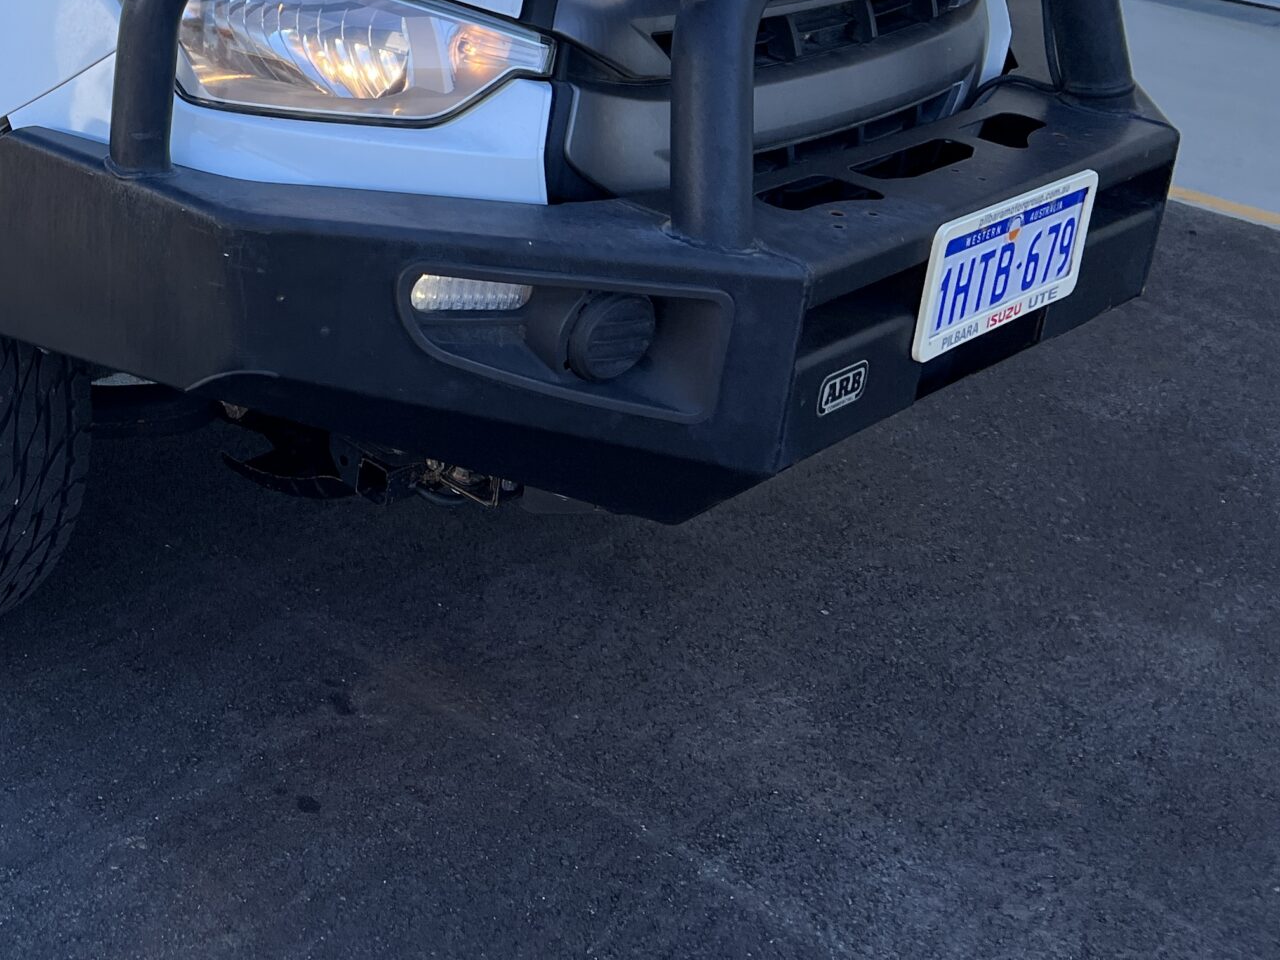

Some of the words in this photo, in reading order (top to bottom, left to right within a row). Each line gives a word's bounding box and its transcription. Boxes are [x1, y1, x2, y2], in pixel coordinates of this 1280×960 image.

[965, 225, 1002, 248] WESTERN
[1029, 200, 1064, 222] AUSTRALIA
[941, 321, 980, 350] PILBARA
[986, 302, 1023, 329] ISUZU
[1028, 286, 1060, 308] UTE
[824, 370, 863, 407] ARB
